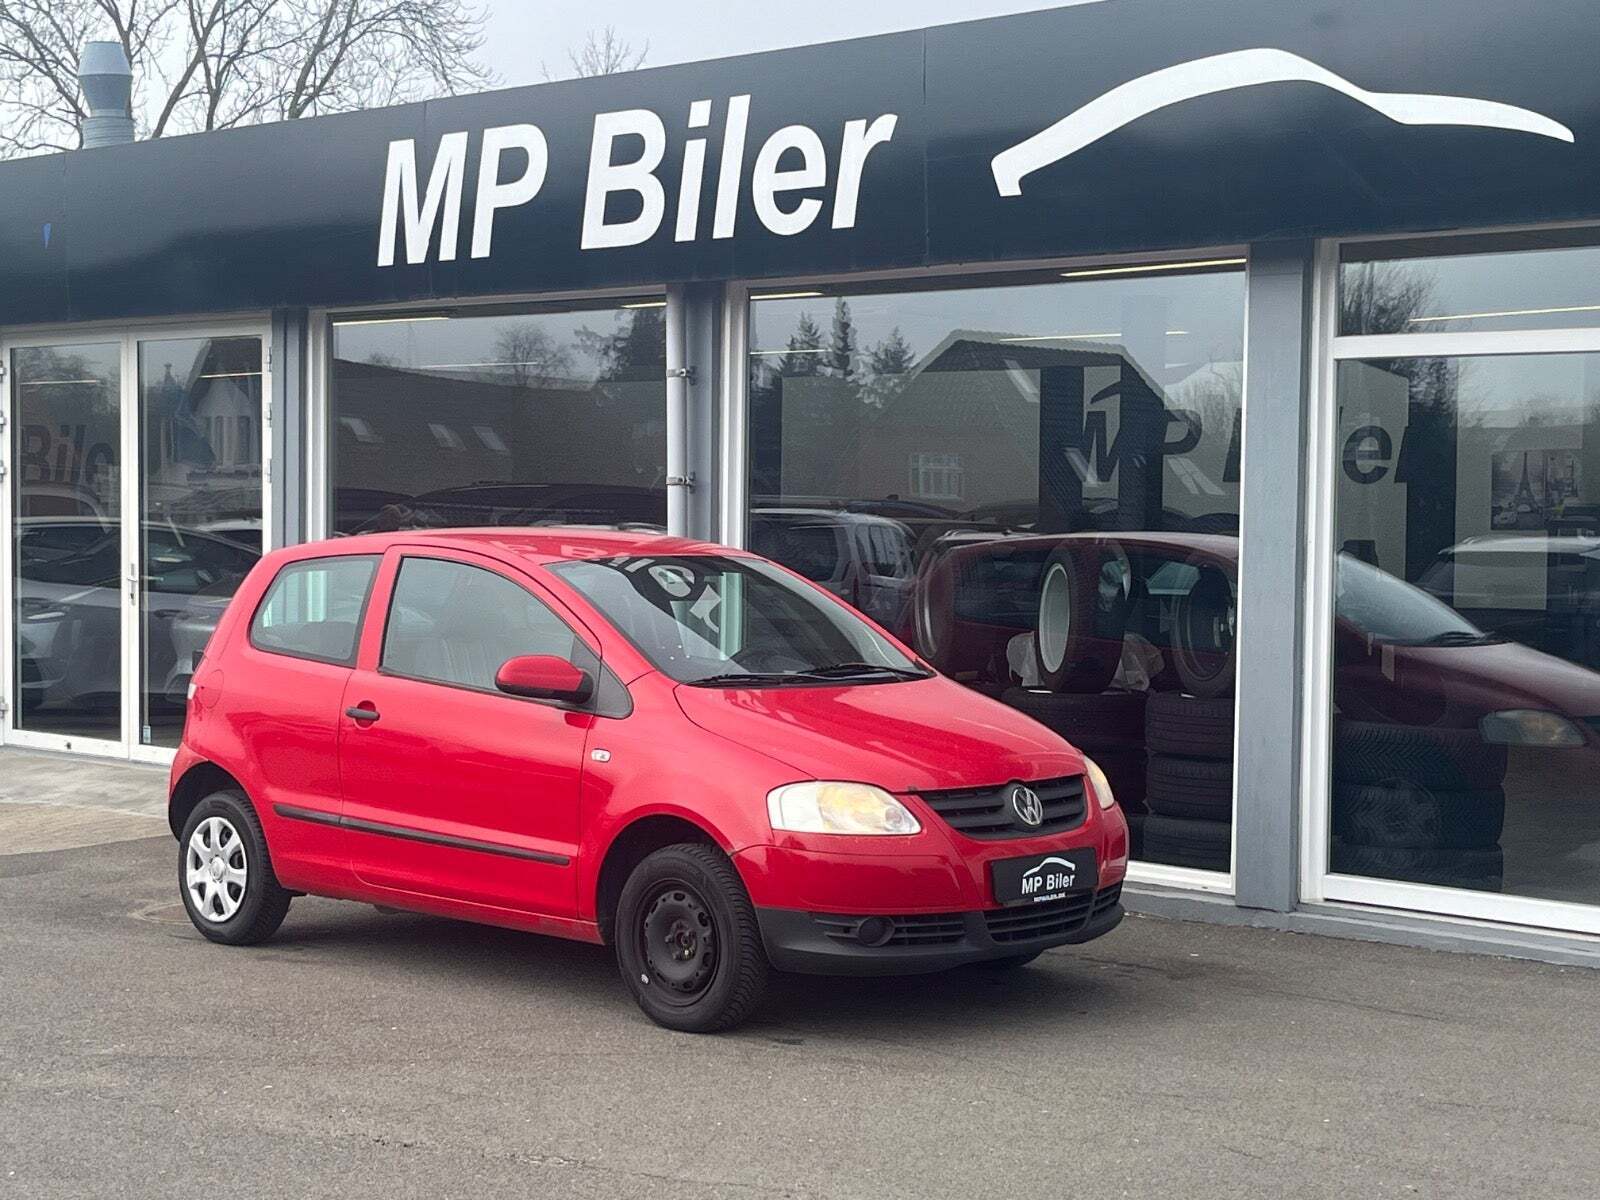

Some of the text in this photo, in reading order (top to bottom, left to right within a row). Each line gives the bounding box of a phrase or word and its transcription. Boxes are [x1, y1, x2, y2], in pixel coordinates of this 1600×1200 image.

[377, 94, 898, 267] MP Biler
[1022, 873, 1076, 895] MP Biler
